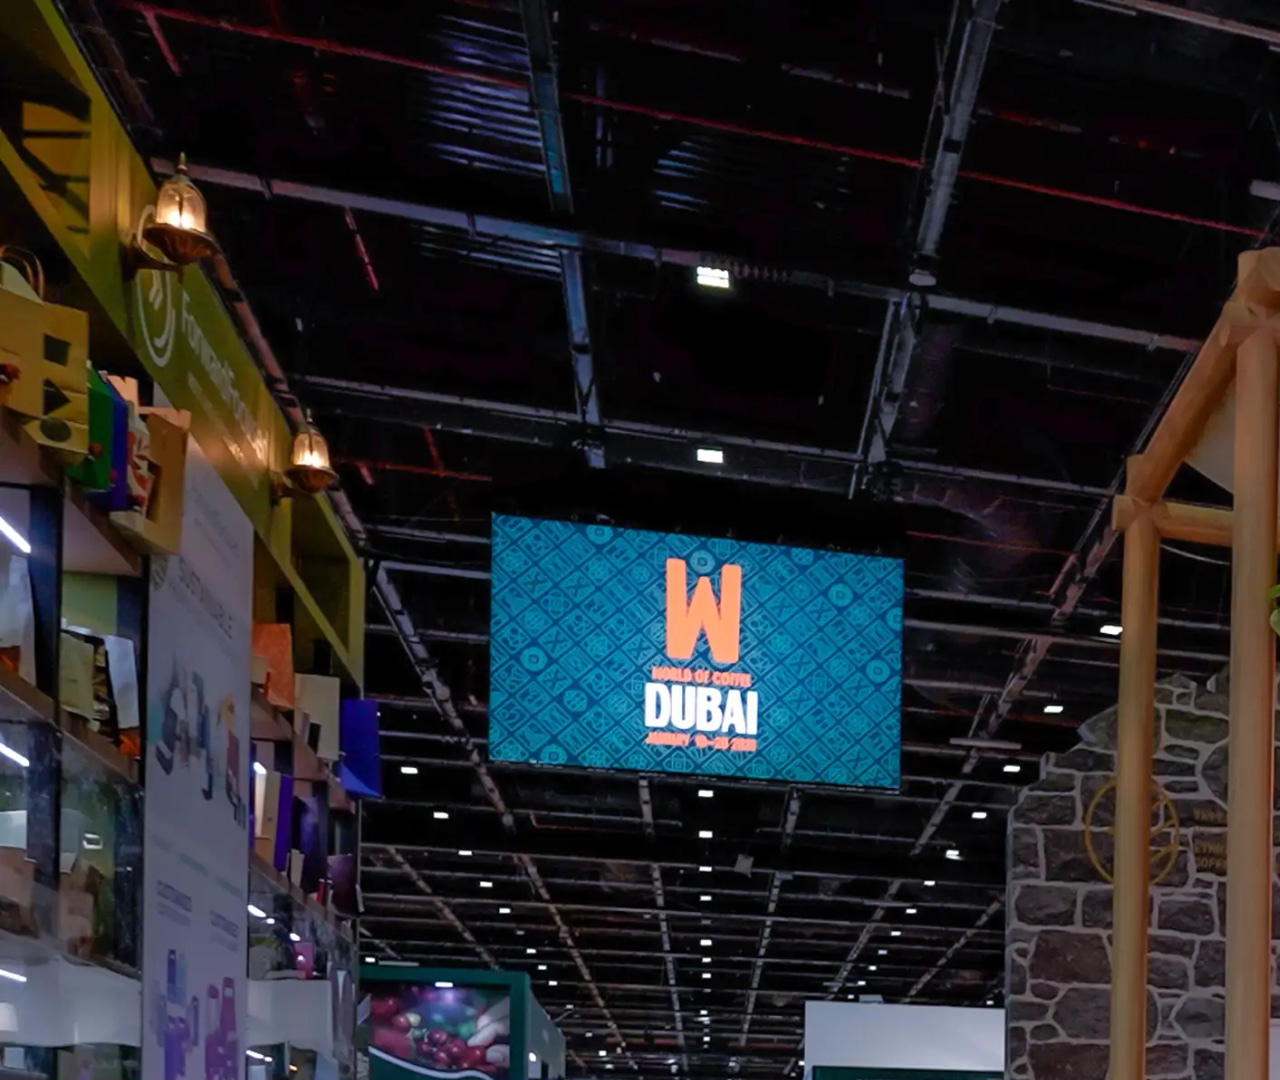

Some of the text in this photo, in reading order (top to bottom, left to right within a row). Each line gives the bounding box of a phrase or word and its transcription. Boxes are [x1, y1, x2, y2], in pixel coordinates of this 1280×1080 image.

[666, 558, 742, 663] W
[652, 666, 752, 688] WORLD OF COFFEE
[644, 682, 758, 735] DUBAI
